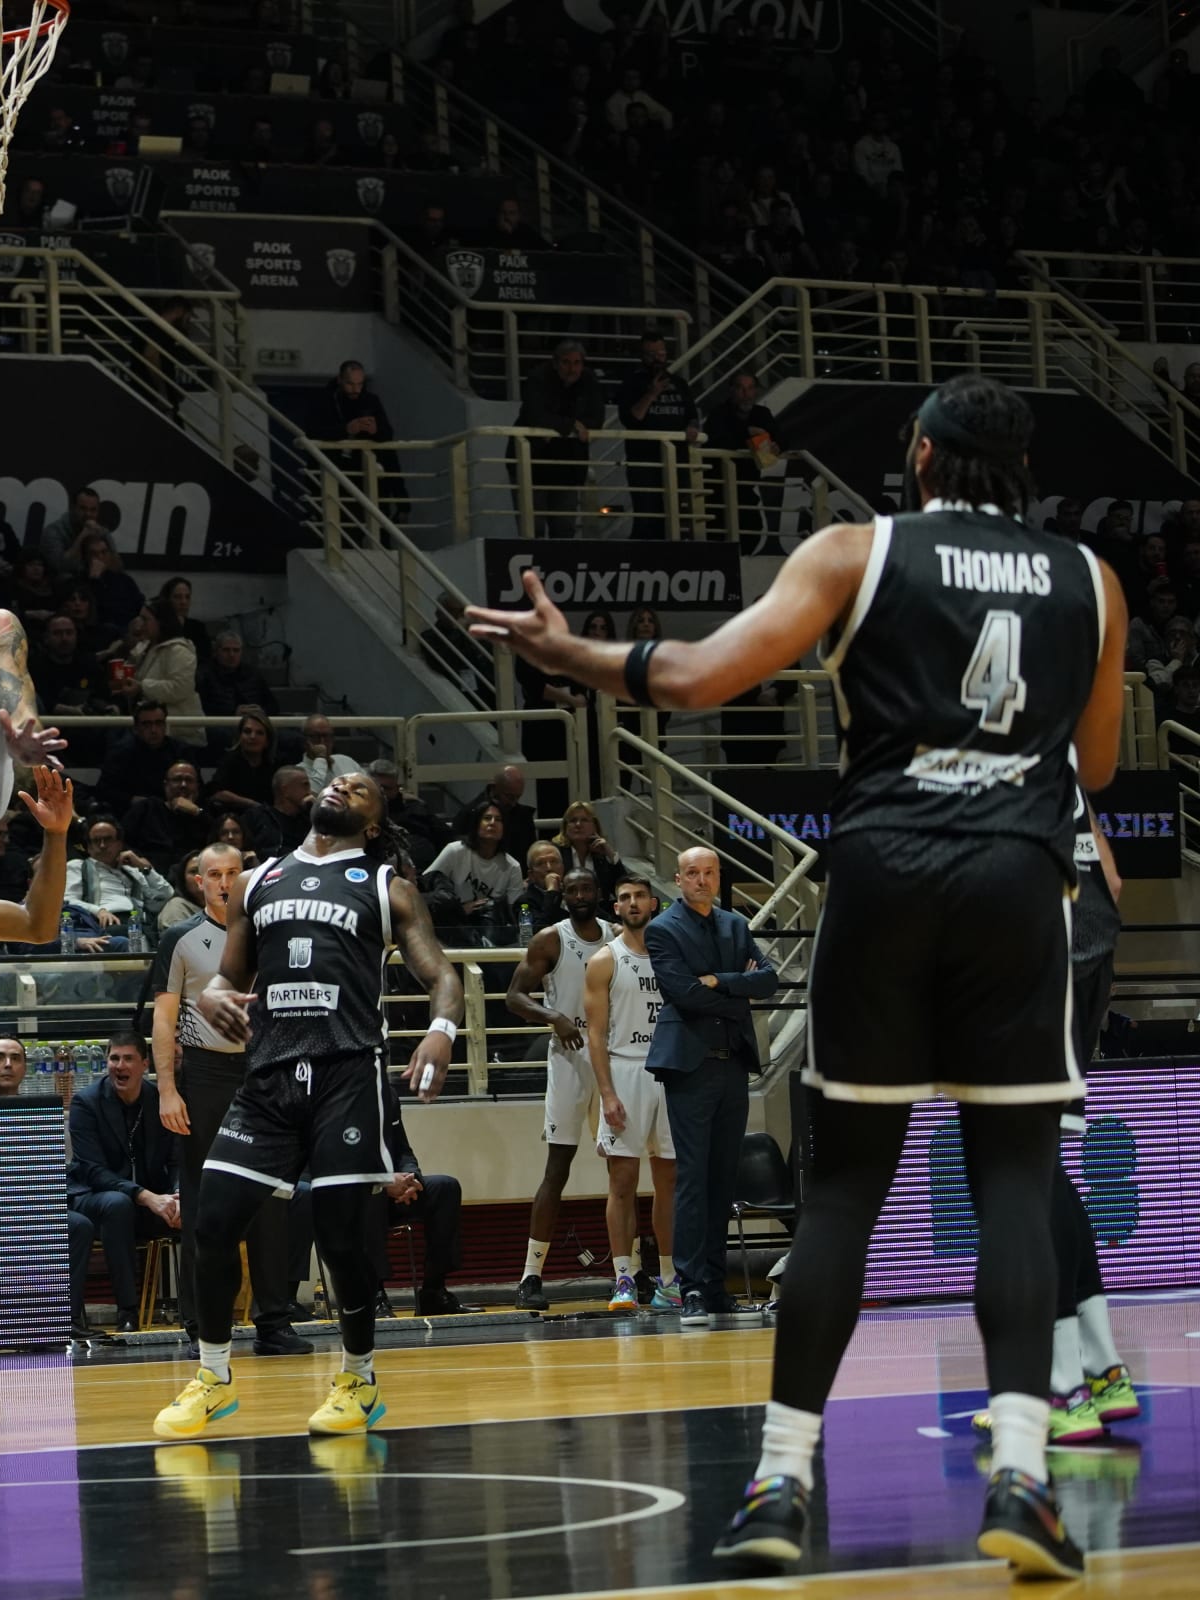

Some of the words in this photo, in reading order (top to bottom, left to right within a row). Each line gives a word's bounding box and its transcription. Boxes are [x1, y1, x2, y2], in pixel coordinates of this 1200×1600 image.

[193, 168, 231, 181] PAOK
[184, 183, 240, 197] SPORTS
[253, 241, 292, 254] PAOK
[245, 257, 302, 272] SPORTS
[498, 254, 529, 269] PAOK
[250, 274, 299, 288] ARENA
[493, 270, 537, 285] SPORTS
[498, 286, 537, 300] ARENA
[212, 541, 243, 557] 21+
[934, 544, 1052, 597] THOMAS
[960, 609, 1028, 736] 4
[253, 898, 359, 937] PRIEVIDZA
[288, 937, 313, 968] 15
[270, 988, 331, 1001] PARTNERS
